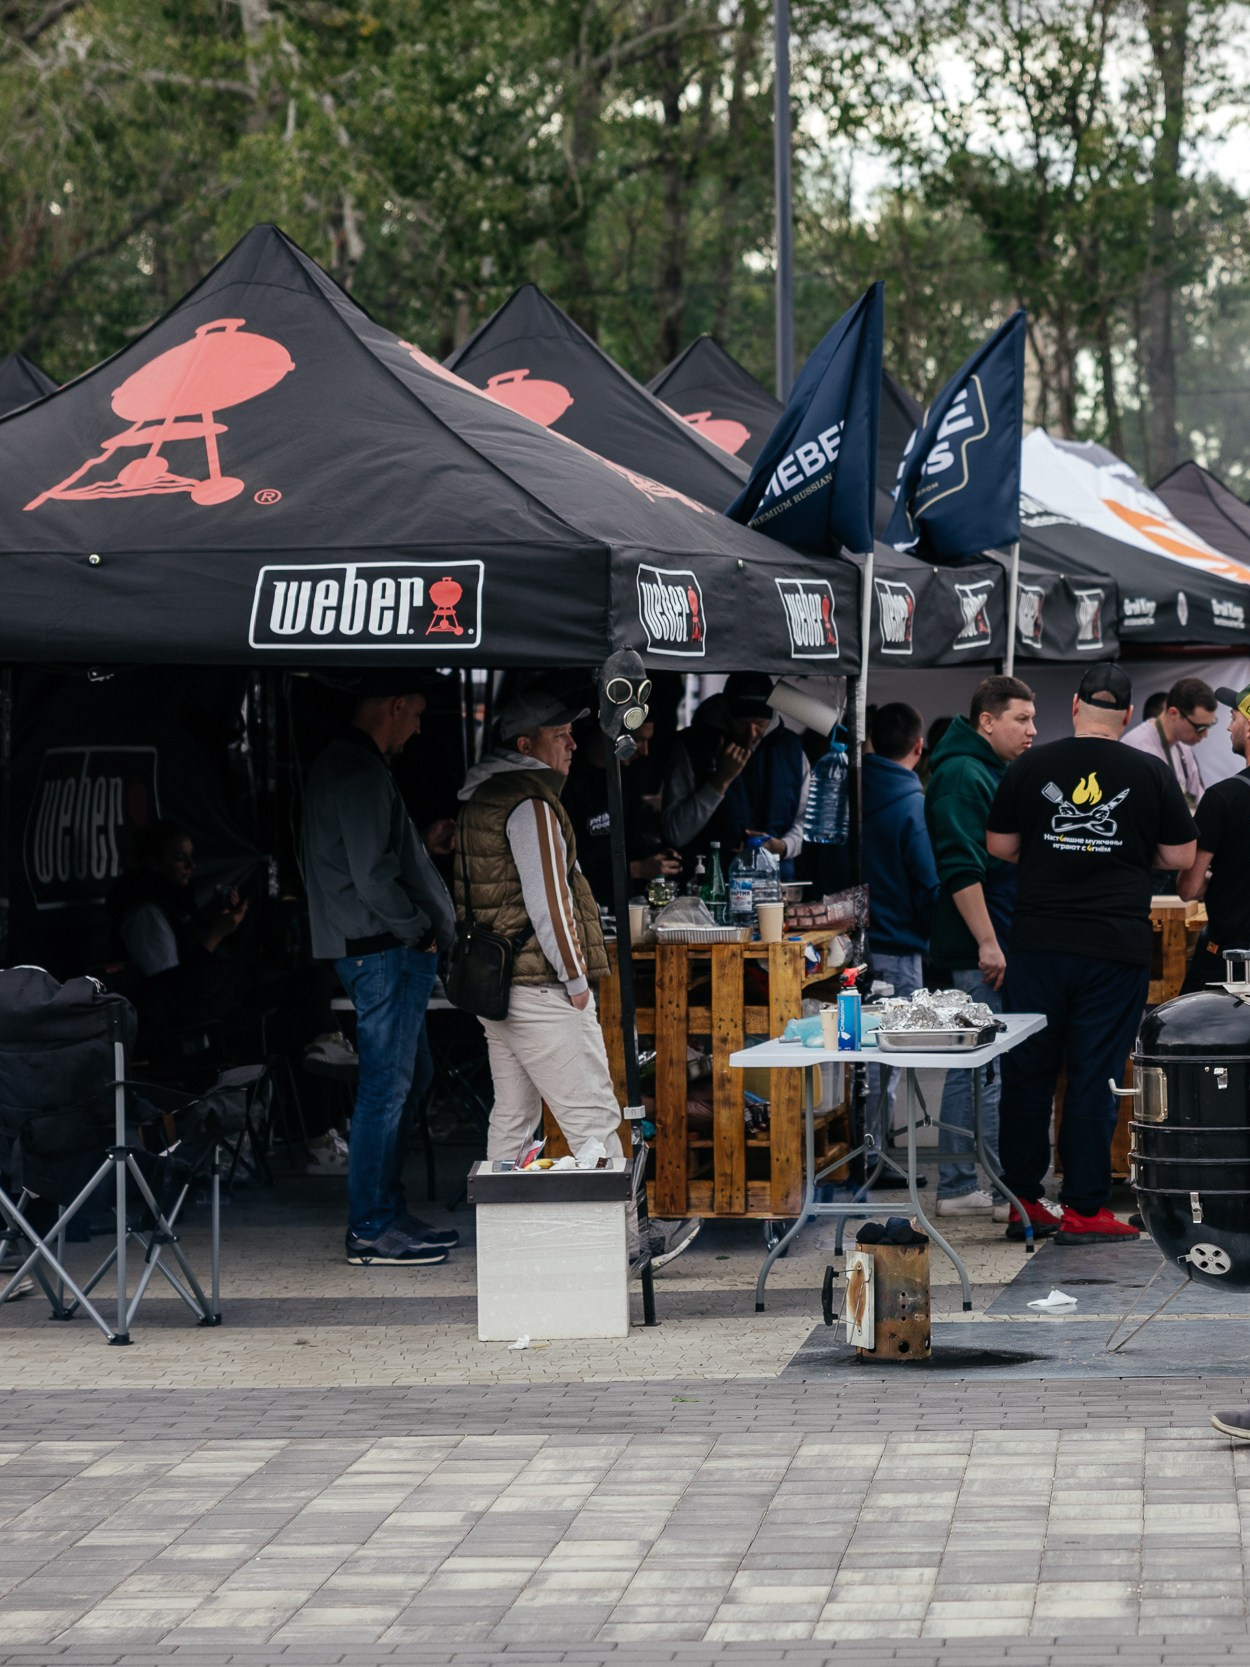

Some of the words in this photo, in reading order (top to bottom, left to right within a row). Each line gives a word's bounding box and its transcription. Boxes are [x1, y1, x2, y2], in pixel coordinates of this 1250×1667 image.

[792, 472, 834, 504] RUSSIAN
[269, 567, 425, 636] weber
[640, 574, 690, 643] weber
[783, 584, 826, 647] weber
[34, 751, 124, 884] weber
